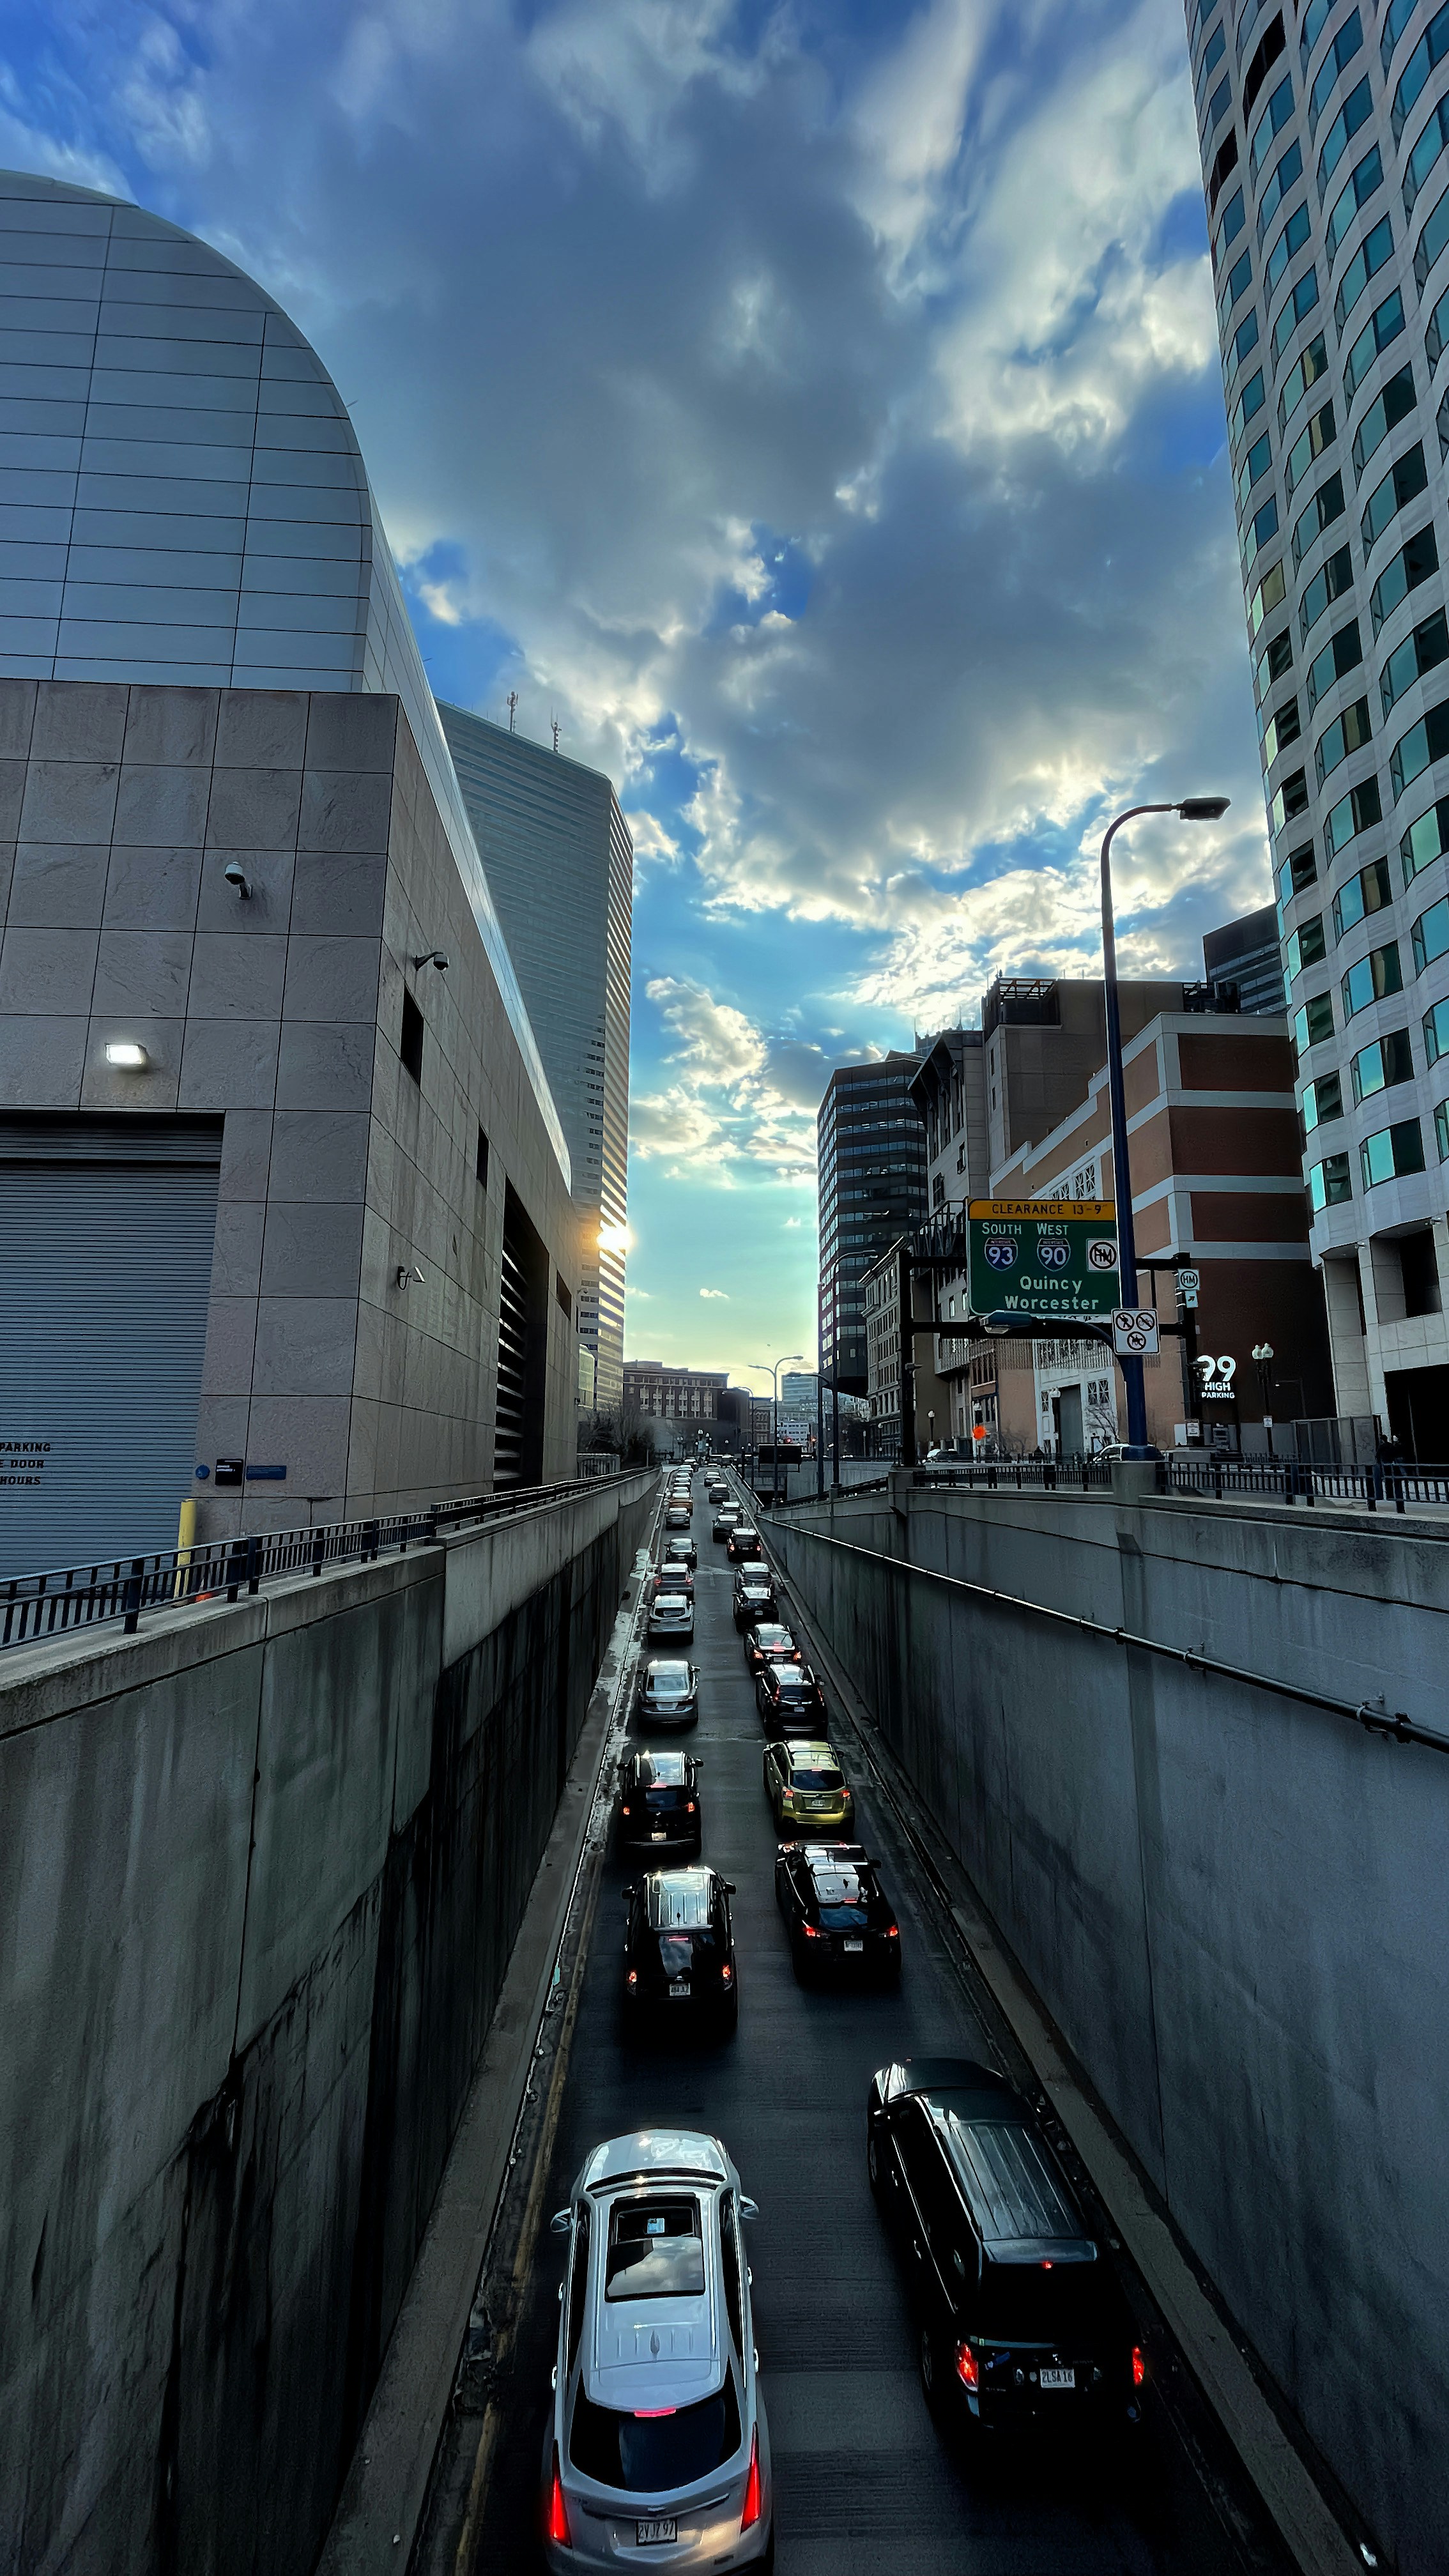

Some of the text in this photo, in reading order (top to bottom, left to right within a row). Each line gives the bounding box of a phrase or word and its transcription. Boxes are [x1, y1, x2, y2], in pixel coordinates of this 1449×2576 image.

[992, 1204, 1064, 1214] CLEARANCE
[982, 1222, 1068, 1235] SOUTH WEST
[988, 1246, 1013, 1265] 93
[1041, 1247, 1066, 1265] 90
[1020, 1275, 1082, 1294] Quincy
[1183, 1275, 1195, 1284] HM
[1004, 1295, 1099, 1310] Worcester
[1196, 1354, 1236, 1381] 99
[1204, 1382, 1230, 1391] HIGH
[0, 1442, 51, 1452] PARKING
[10, 1459, 45, 1468] DOOR
[0, 1476, 41, 1485] HOURS
